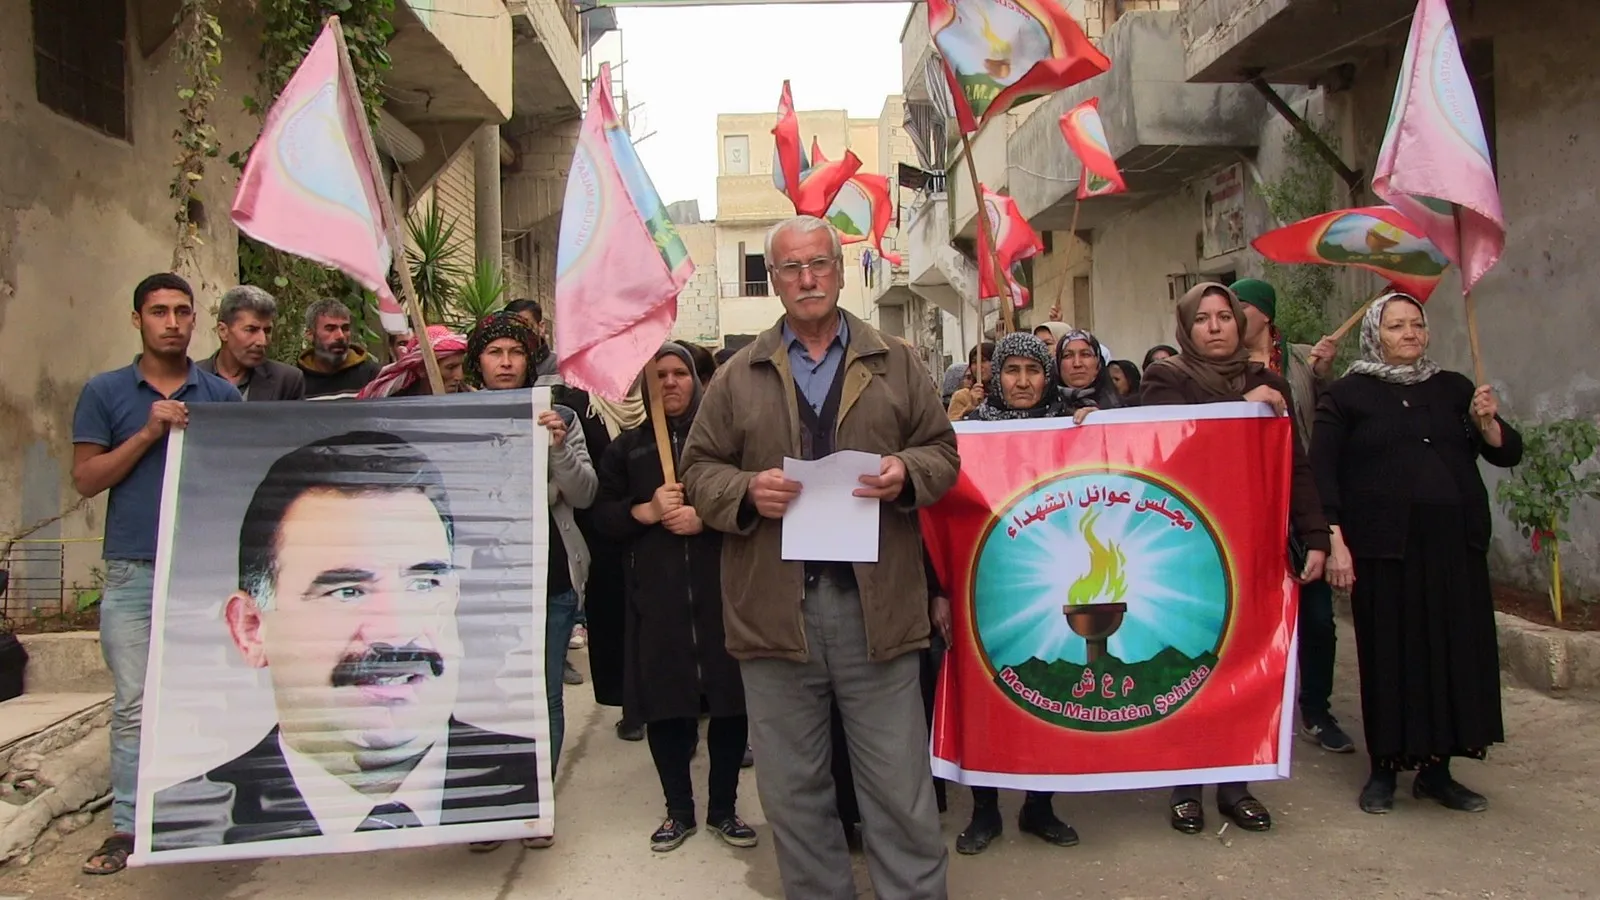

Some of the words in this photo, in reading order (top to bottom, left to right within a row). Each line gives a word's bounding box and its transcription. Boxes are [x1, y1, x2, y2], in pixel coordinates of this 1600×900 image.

[1006, 490, 1074, 539] الشهداء
[1134, 497, 1195, 532] مجلس
[1063, 702, 1152, 723] Malbatên
